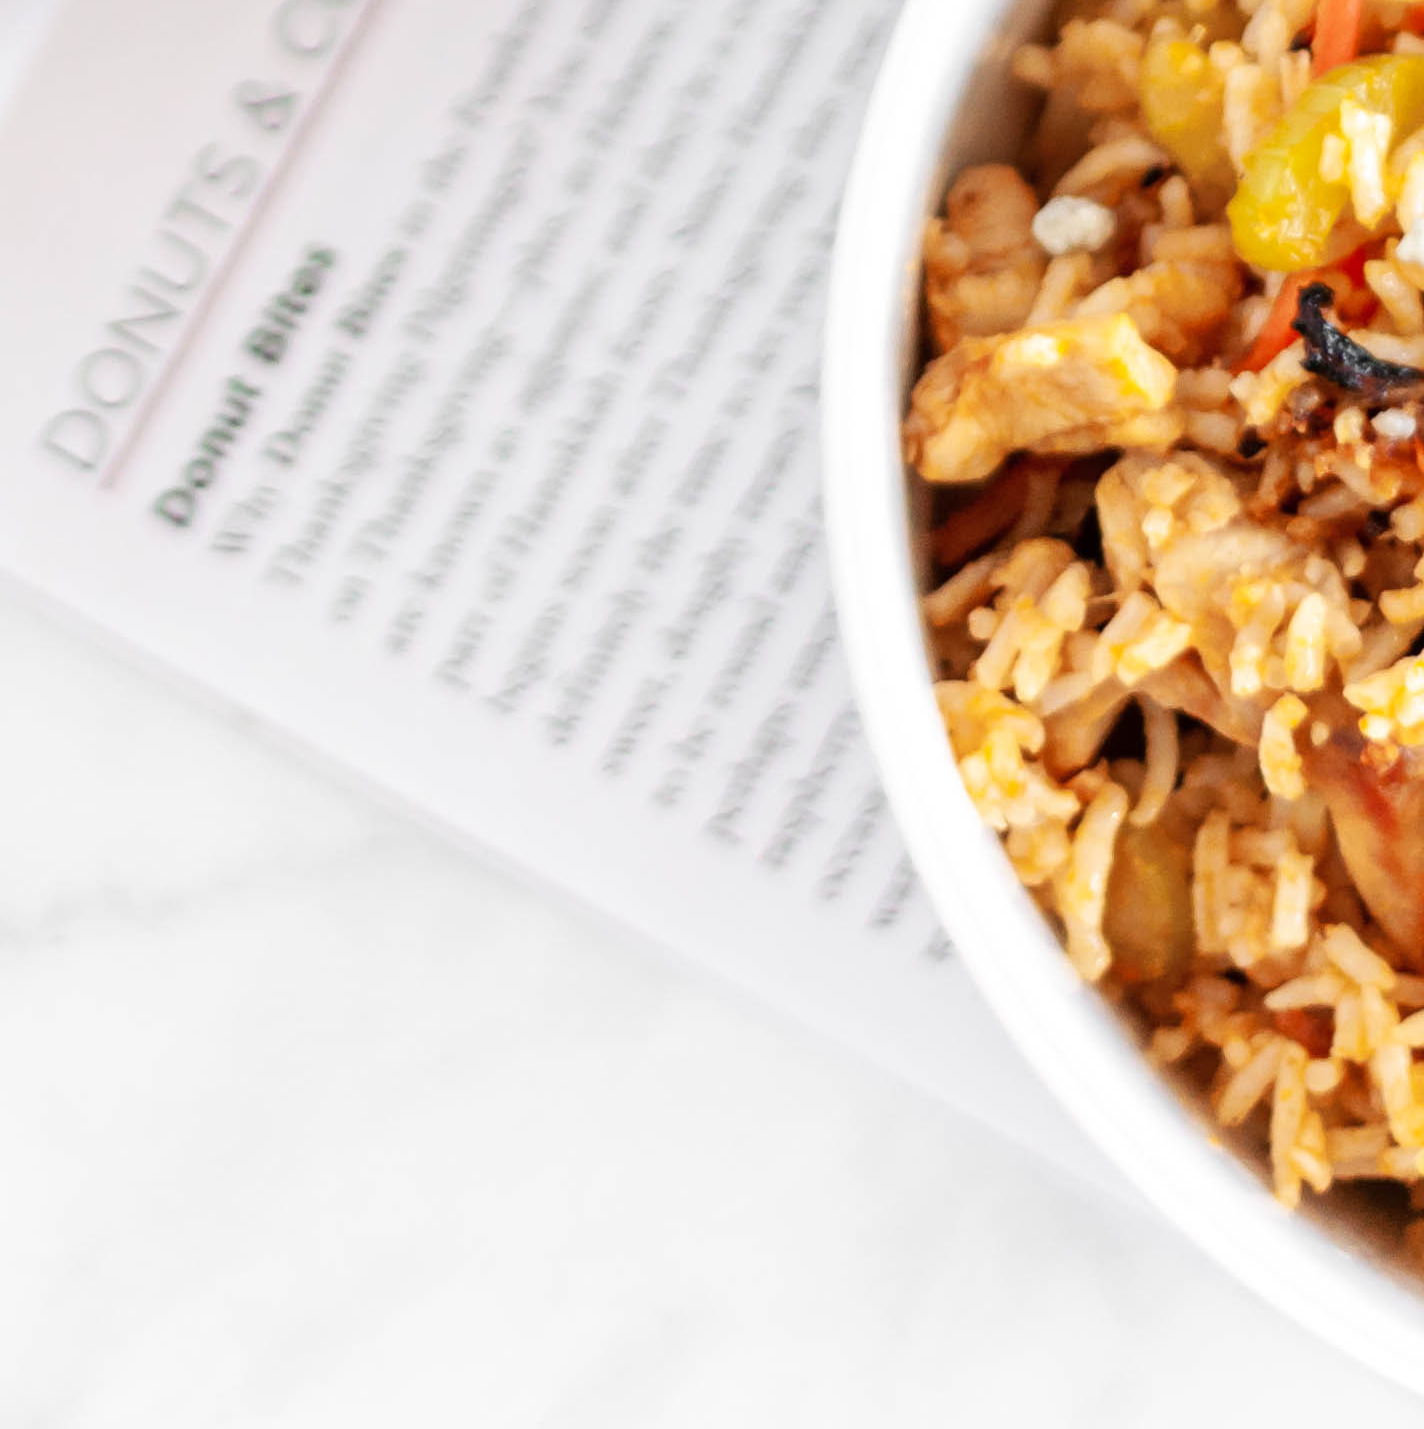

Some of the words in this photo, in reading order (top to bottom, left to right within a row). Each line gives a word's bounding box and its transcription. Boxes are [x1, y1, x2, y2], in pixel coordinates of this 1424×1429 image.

[34, 130, 267, 477] DONUTS
[221, 62, 304, 139] &
[148, 368, 268, 534] Donut
[238, 231, 343, 371] Bites
[261, 340, 357, 471] Donut
